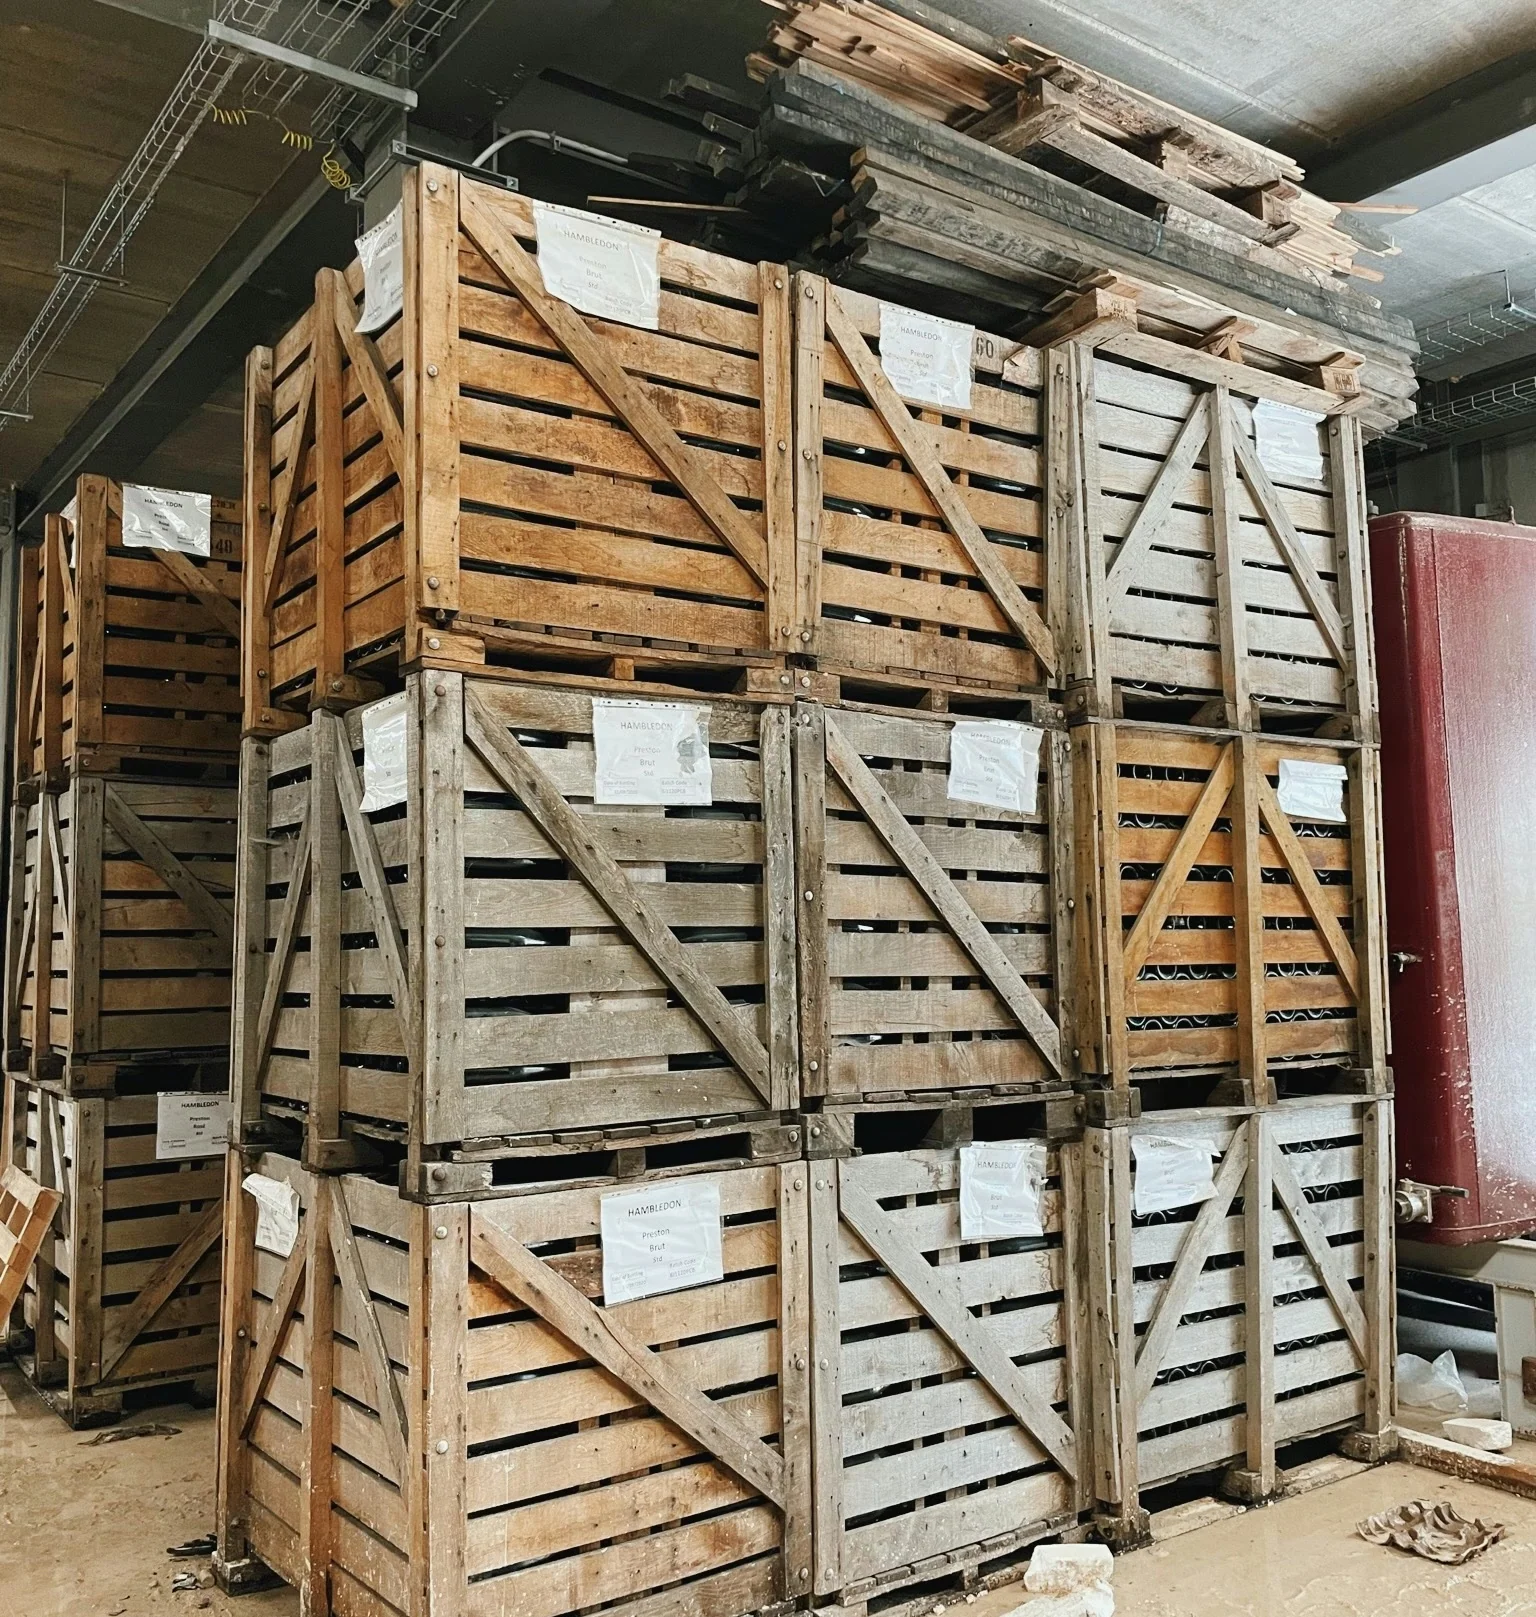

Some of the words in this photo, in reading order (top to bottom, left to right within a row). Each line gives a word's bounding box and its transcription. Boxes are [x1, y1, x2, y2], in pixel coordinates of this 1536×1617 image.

[563, 229, 620, 251] HAMBLEDON
[900, 326, 943, 341] HAMBLEDON
[620, 721, 673, 732] HAMBLEDON
[634, 746, 661, 754] Preston
[639, 758, 656, 767] Brut
[181, 1100, 220, 1108] HAMBLEDON
[628, 1199, 682, 1217] HAMBLEDON
[642, 1228, 670, 1240] Preston
[649, 1242, 666, 1252] Brut
[652, 1256, 663, 1264] Std
